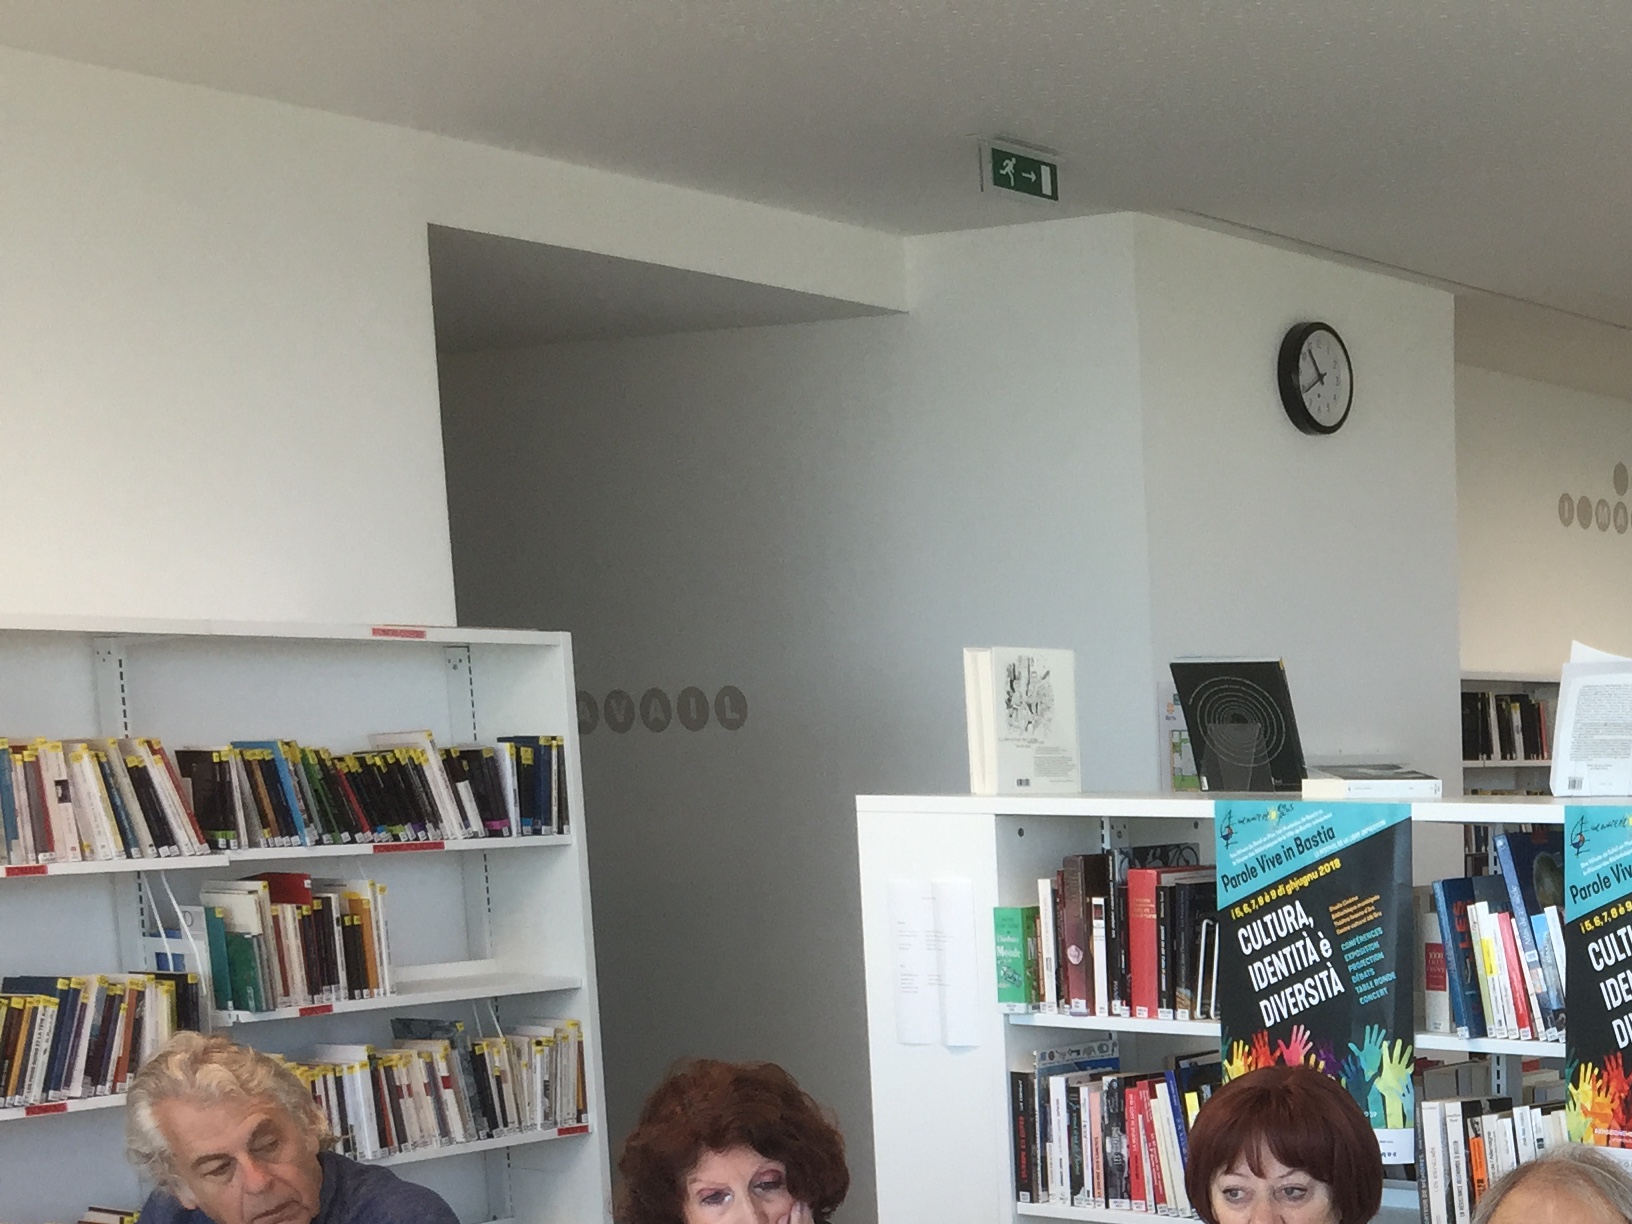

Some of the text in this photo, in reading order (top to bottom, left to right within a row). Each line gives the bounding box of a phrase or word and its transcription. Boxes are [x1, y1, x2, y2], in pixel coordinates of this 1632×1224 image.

[1221, 863, 1257, 892] Parole
[1256, 854, 1283, 873] Vive
[1282, 845, 1295, 861] in
[1294, 825, 1336, 855] Bastia
[1570, 873, 1611, 904] Parole
[1238, 900, 1314, 955] CULTURA,
[1248, 931, 1332, 992] IDENTITÀ è
[1259, 962, 1345, 1028] DIVERSITÀ
